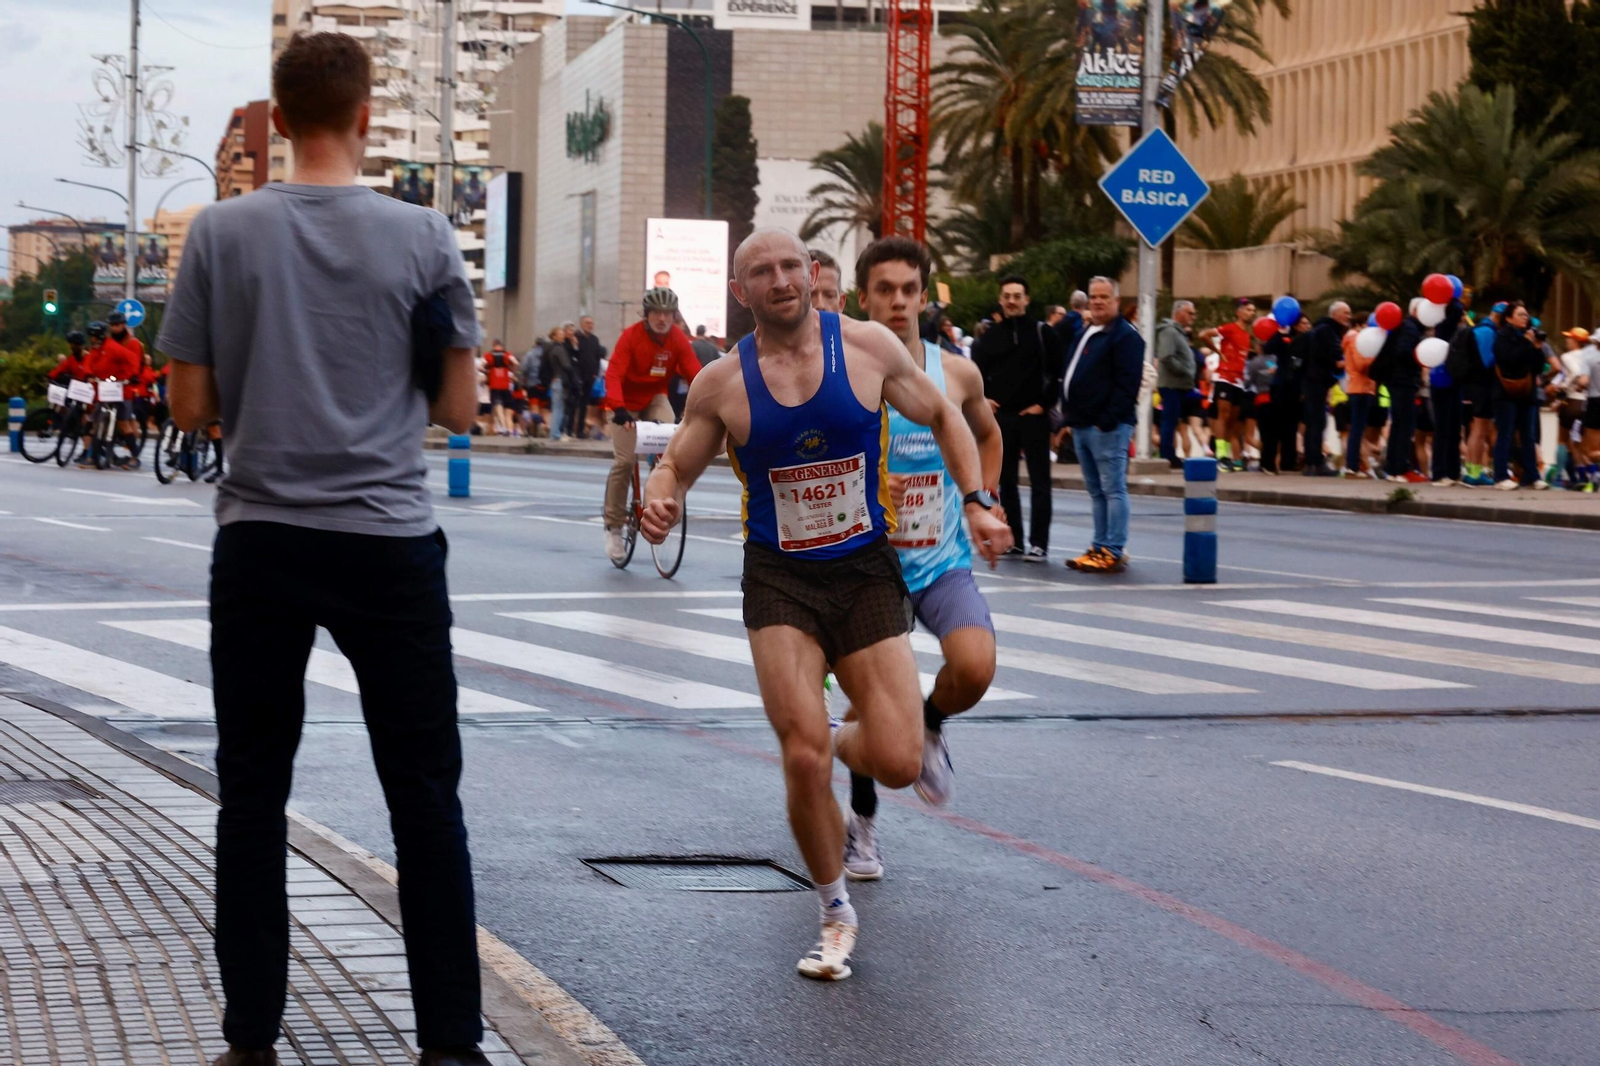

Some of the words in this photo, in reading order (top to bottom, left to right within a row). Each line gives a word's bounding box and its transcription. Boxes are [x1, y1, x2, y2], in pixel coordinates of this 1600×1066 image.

[727, 1, 798, 14] EXPERIENCE
[1138, 168, 1175, 185] RED
[1121, 187, 1190, 207] BÁSICA
[795, 461, 854, 480] GENERALI
[790, 481, 846, 503] 14621
[808, 501, 833, 510] LESTER
